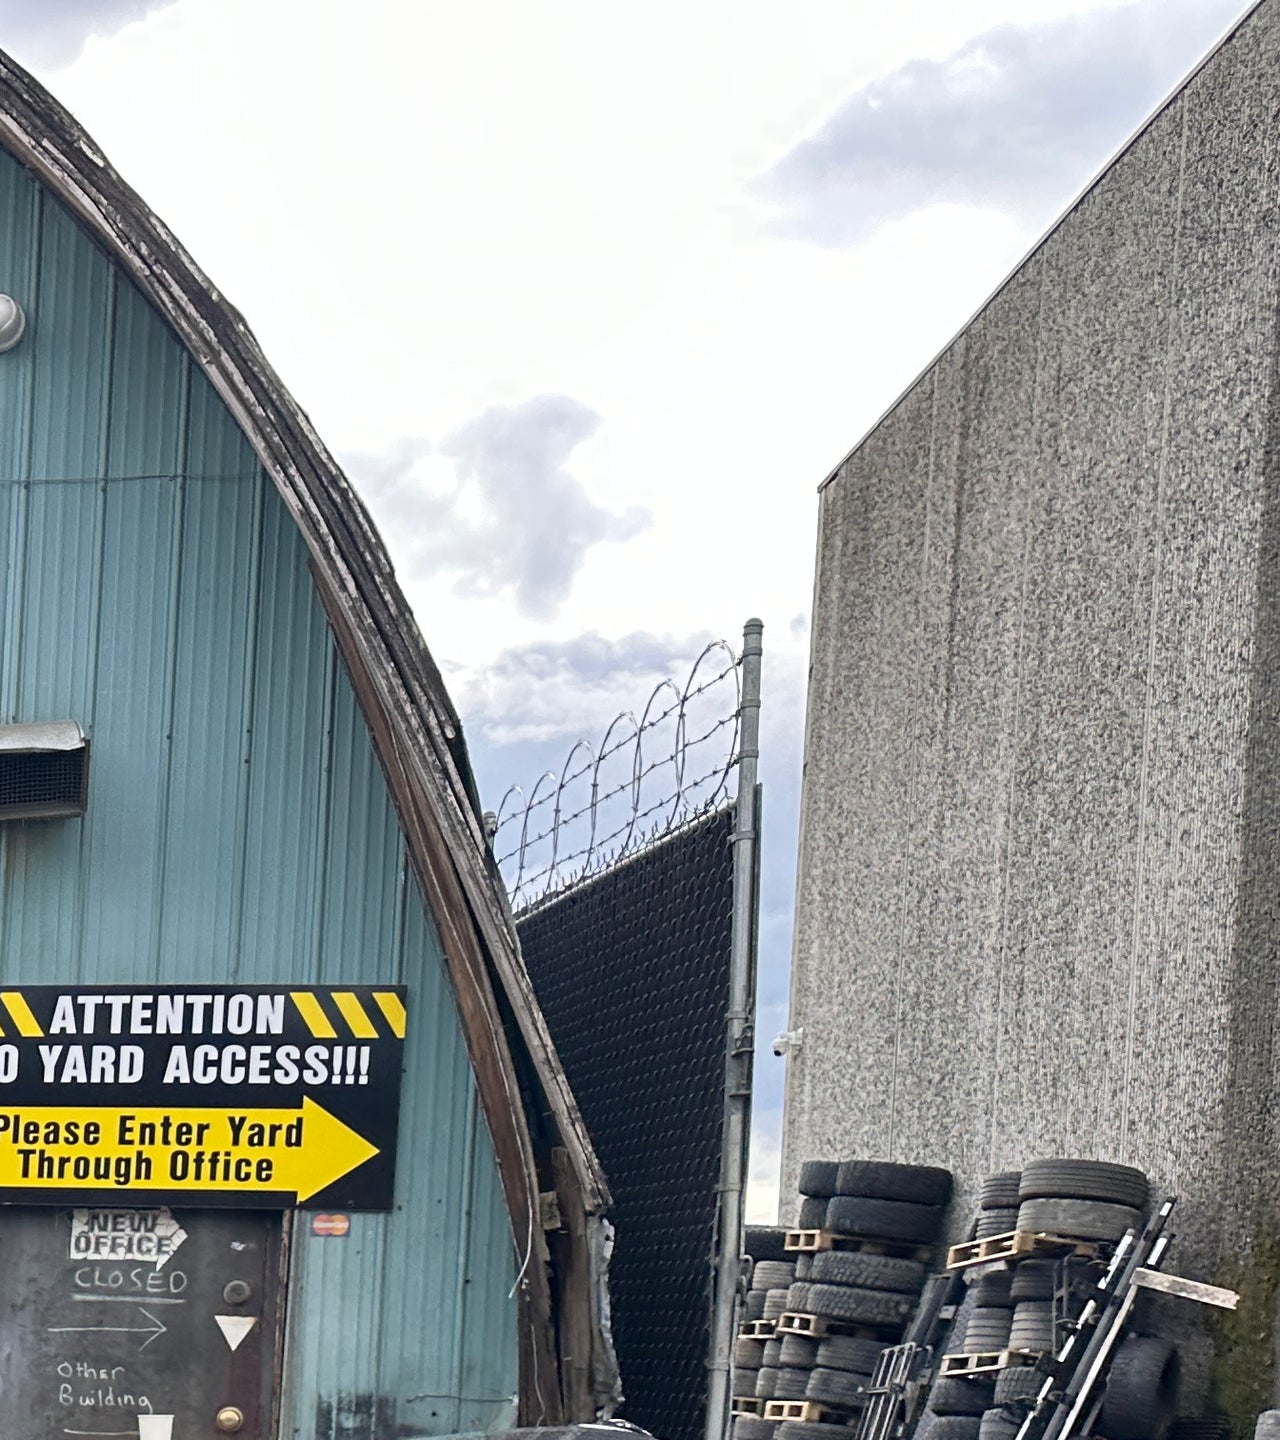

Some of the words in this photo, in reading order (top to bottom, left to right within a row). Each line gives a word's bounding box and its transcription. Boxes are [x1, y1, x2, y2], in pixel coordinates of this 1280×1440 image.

[49, 994, 286, 1036] ATTENTION
[38, 1044, 145, 1085] YARD
[163, 1045, 371, 1086] ACCESS!!!
[117, 1114, 211, 1147] Enter
[226, 1116, 304, 1149] Yard
[16, 1148, 153, 1187] Through
[169, 1149, 274, 1184] Office
[89, 1212, 159, 1233] NEW
[73, 1231, 171, 1256] OFFICE
[75, 1266, 187, 1293] CLOSED
[57, 1361, 125, 1380] Other
[59, 1383, 153, 1415] Building
